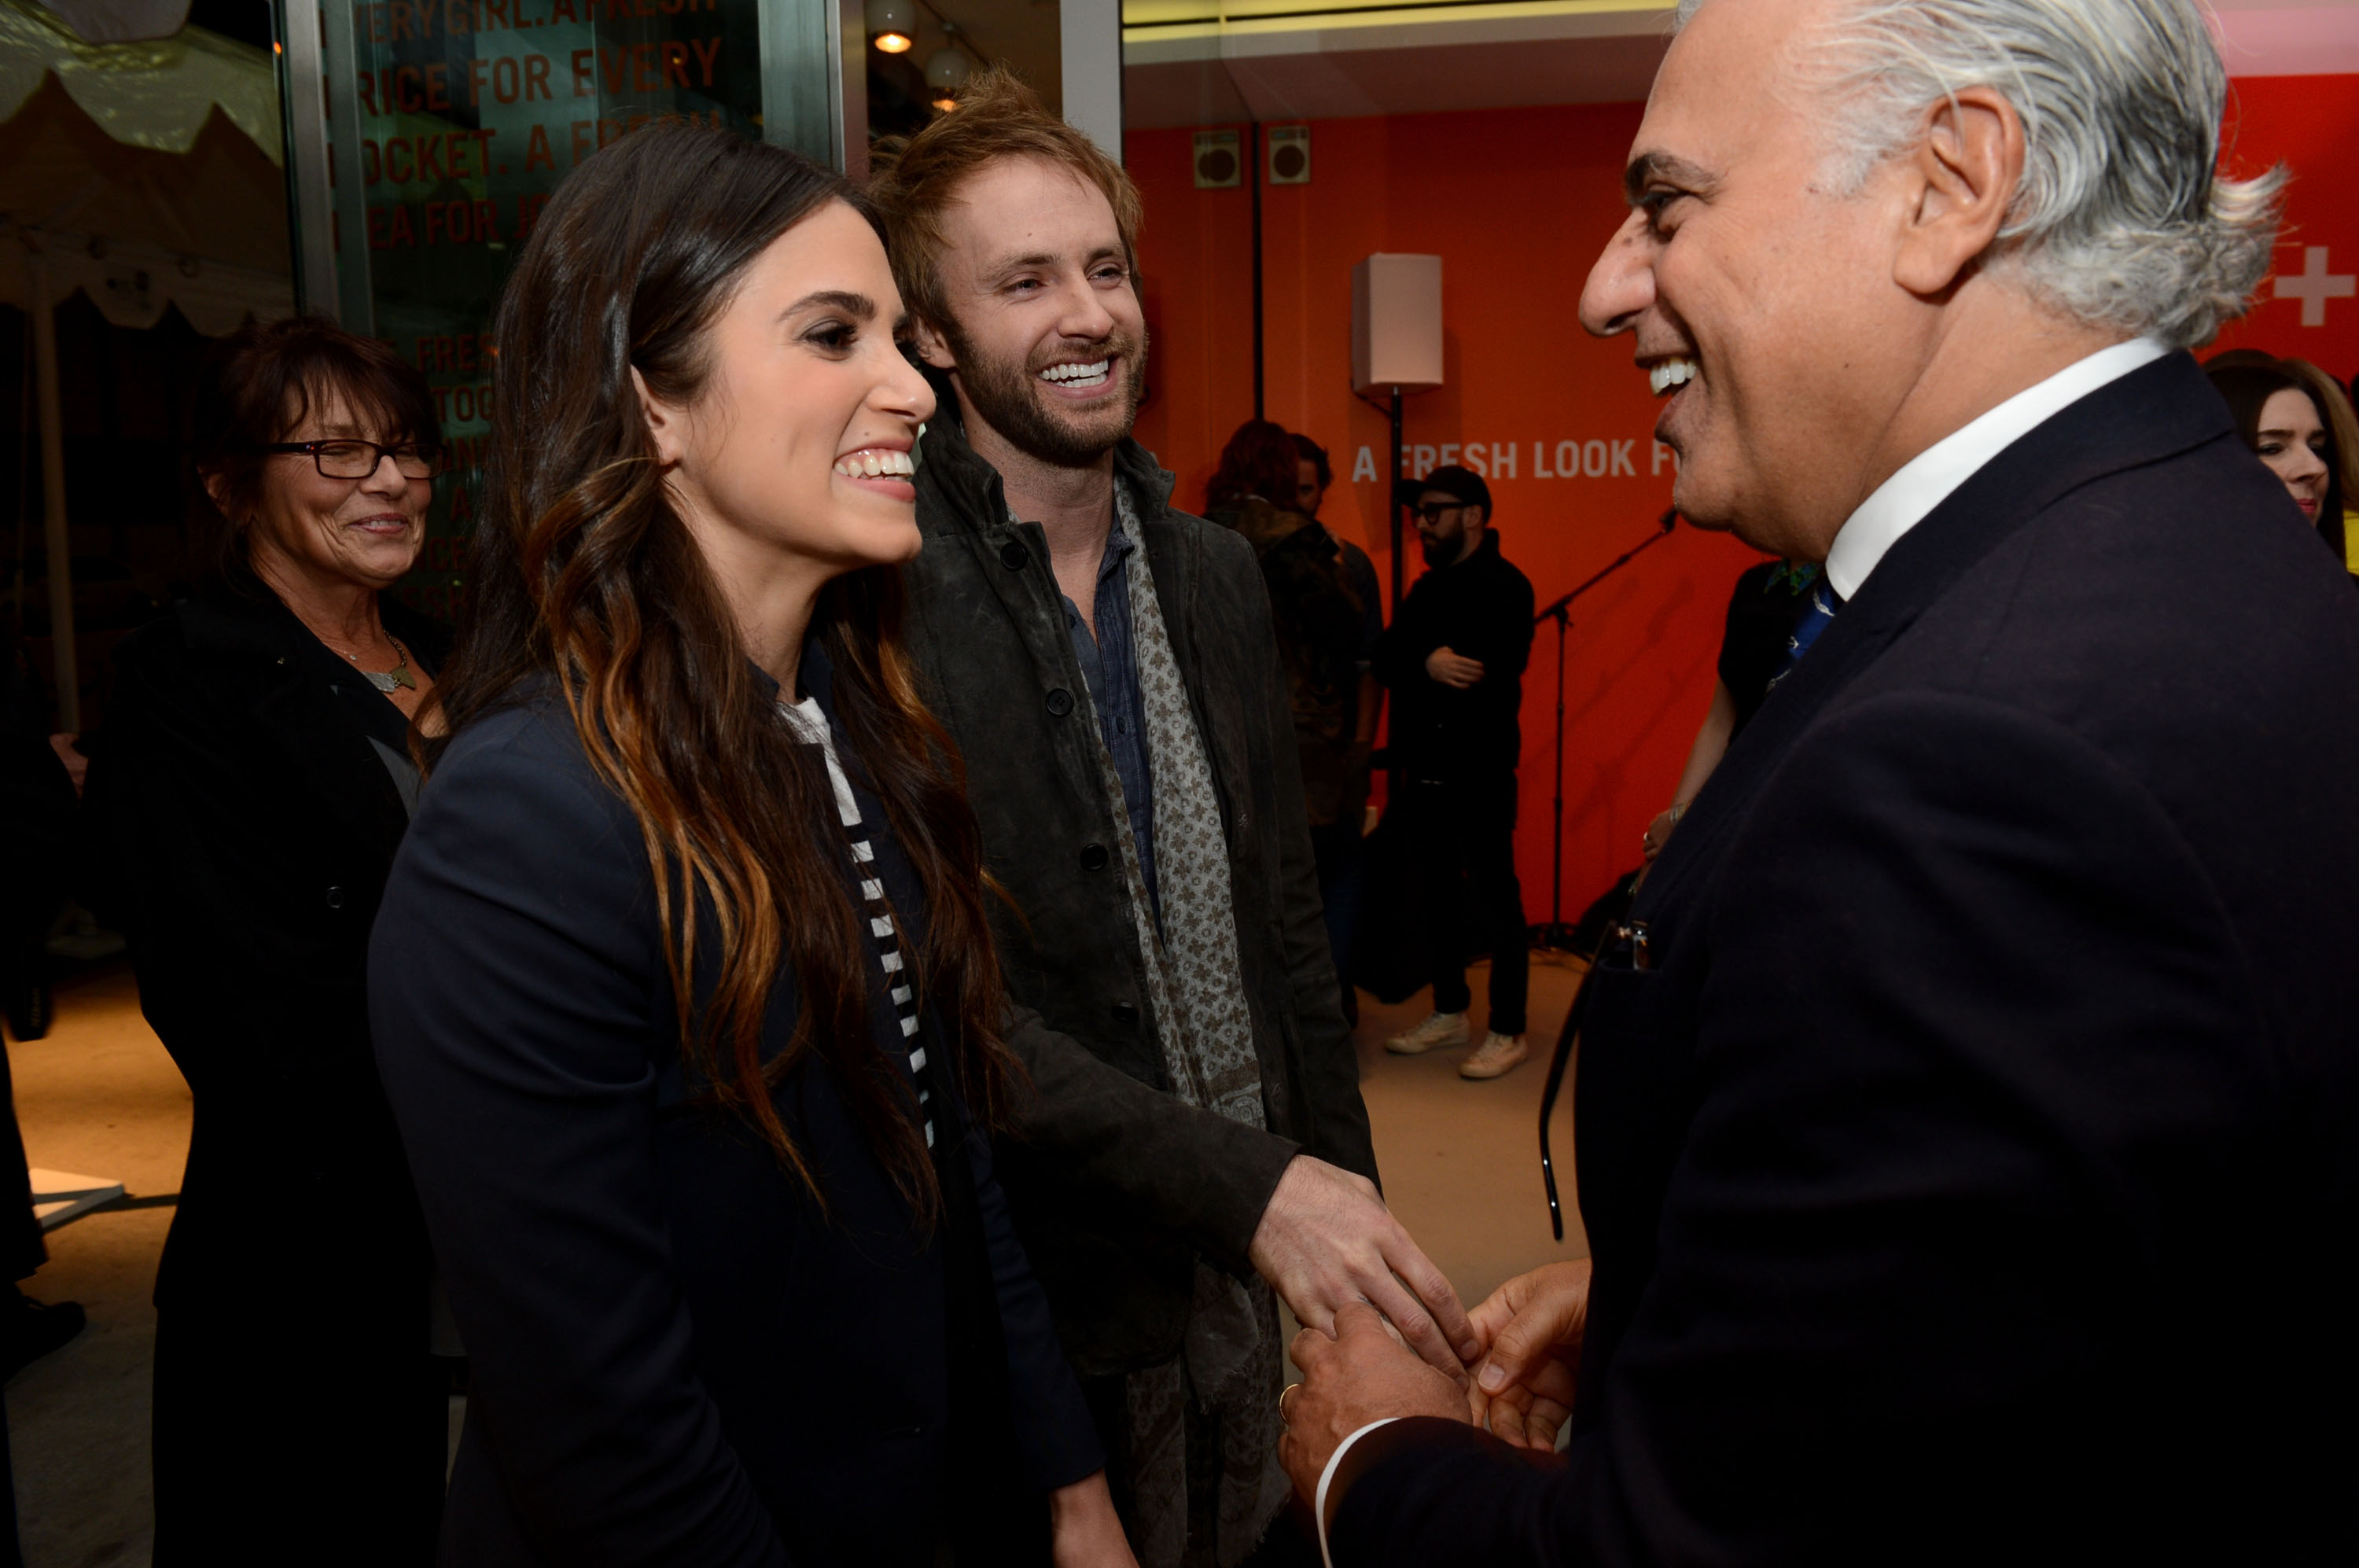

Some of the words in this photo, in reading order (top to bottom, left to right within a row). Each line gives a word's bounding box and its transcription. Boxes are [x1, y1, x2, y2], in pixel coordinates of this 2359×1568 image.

[325, 62, 451, 120] RICE
[469, 54, 553, 108] FOR
[572, 37, 722, 97] EVERY
[328, 129, 508, 187] OCKET.
[525, 124, 556, 173] A
[425, 198, 500, 246] FOR
[1351, 445, 1378, 483] A
[1533, 438, 1637, 479] LOOK
